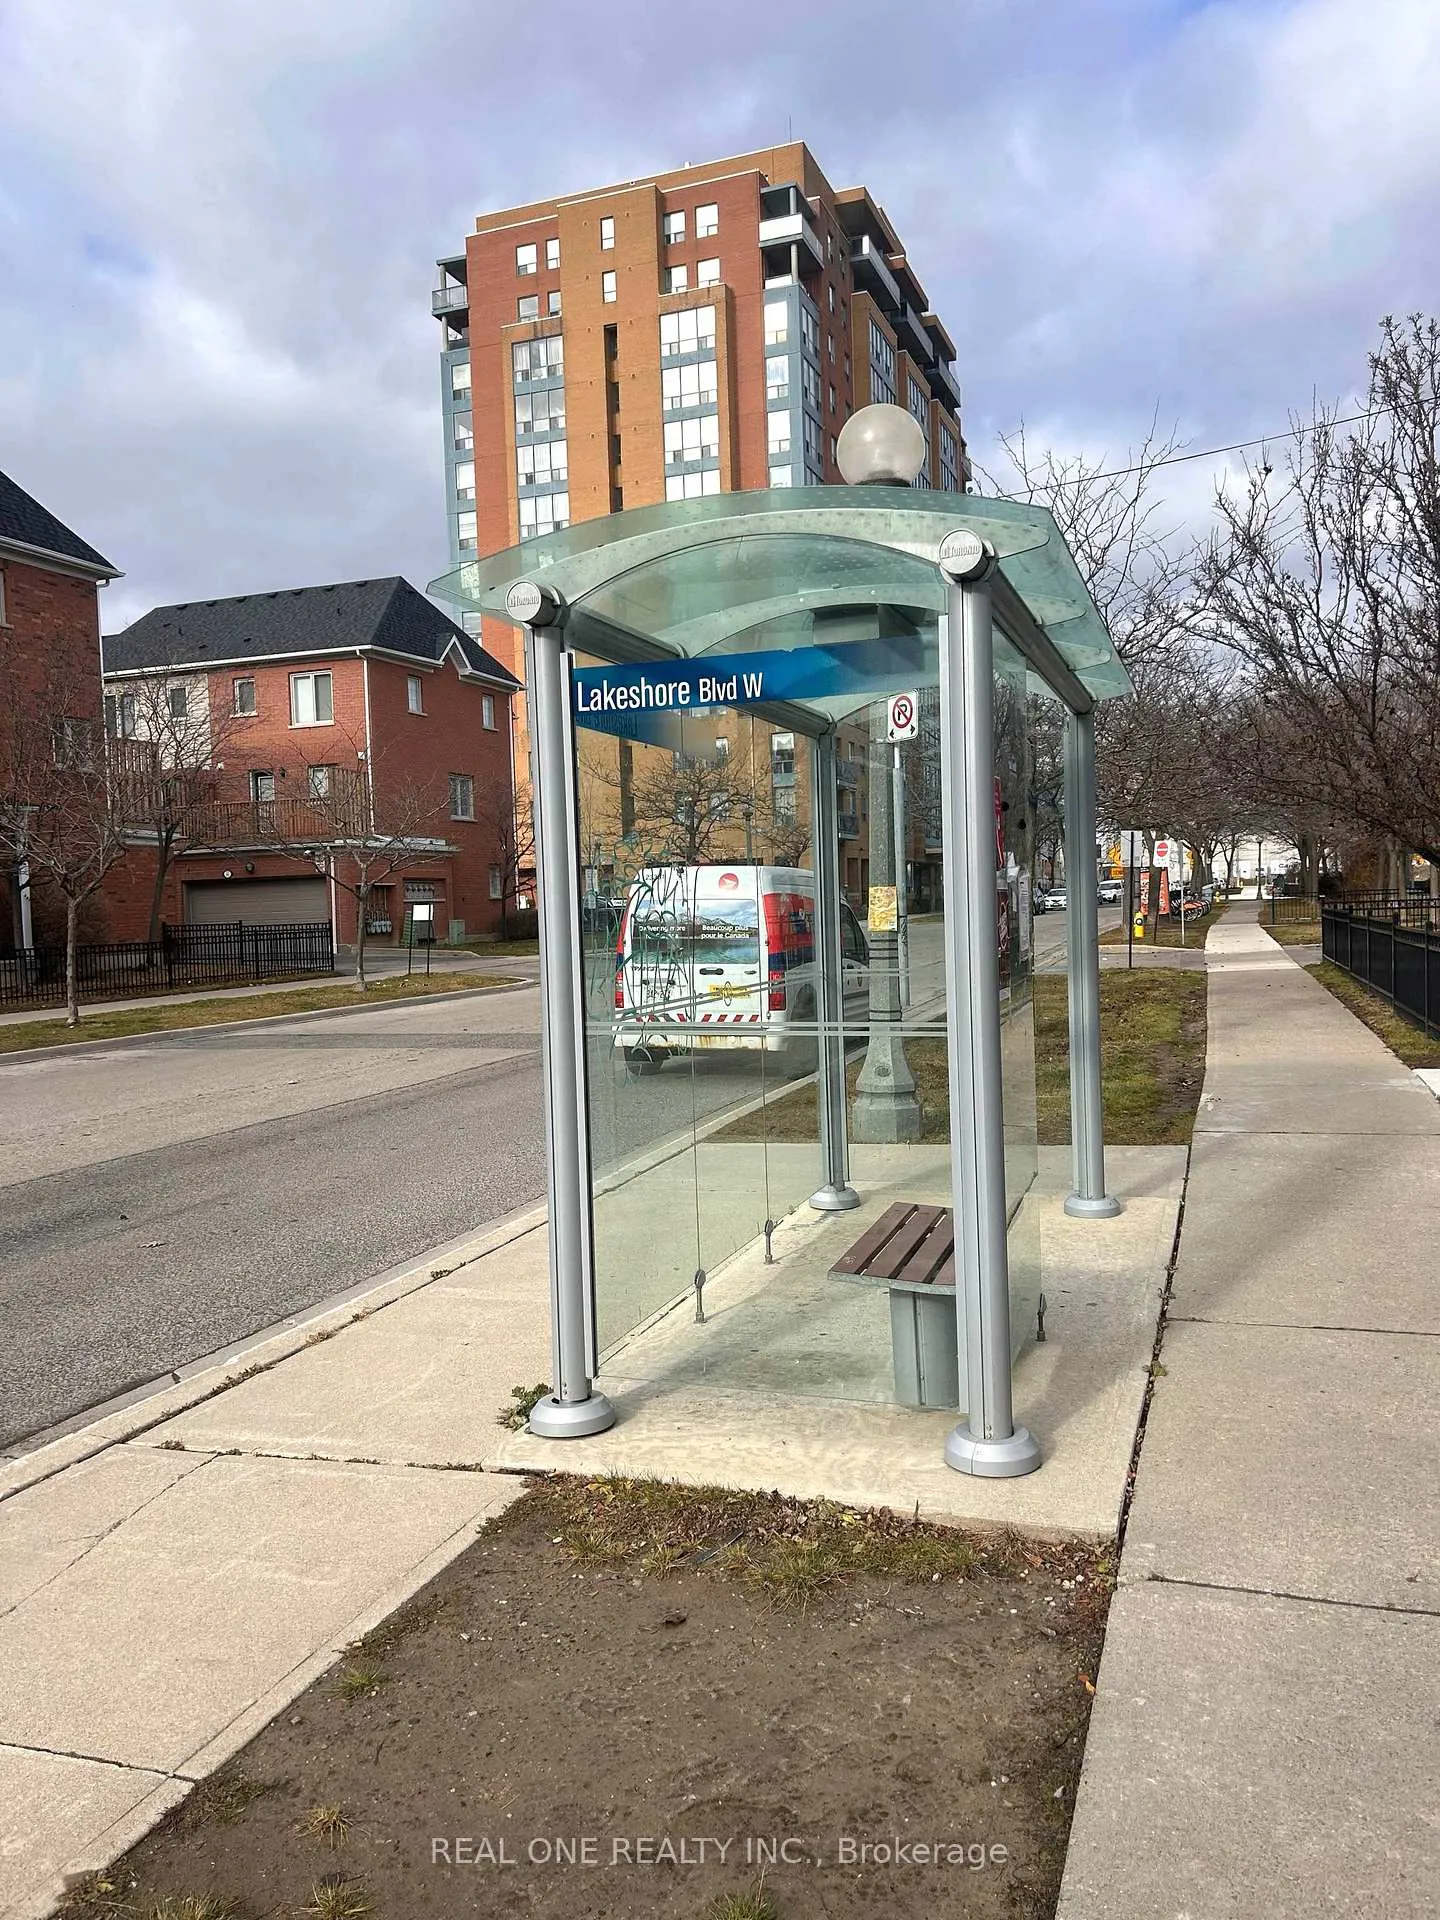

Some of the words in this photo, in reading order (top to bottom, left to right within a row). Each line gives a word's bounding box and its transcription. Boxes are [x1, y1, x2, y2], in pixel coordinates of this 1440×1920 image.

[577, 676, 690, 712] Lakeshore
[699, 675, 737, 703] Blvd
[743, 672, 763, 699] W
[702, 925, 734, 933] Beaucoup
